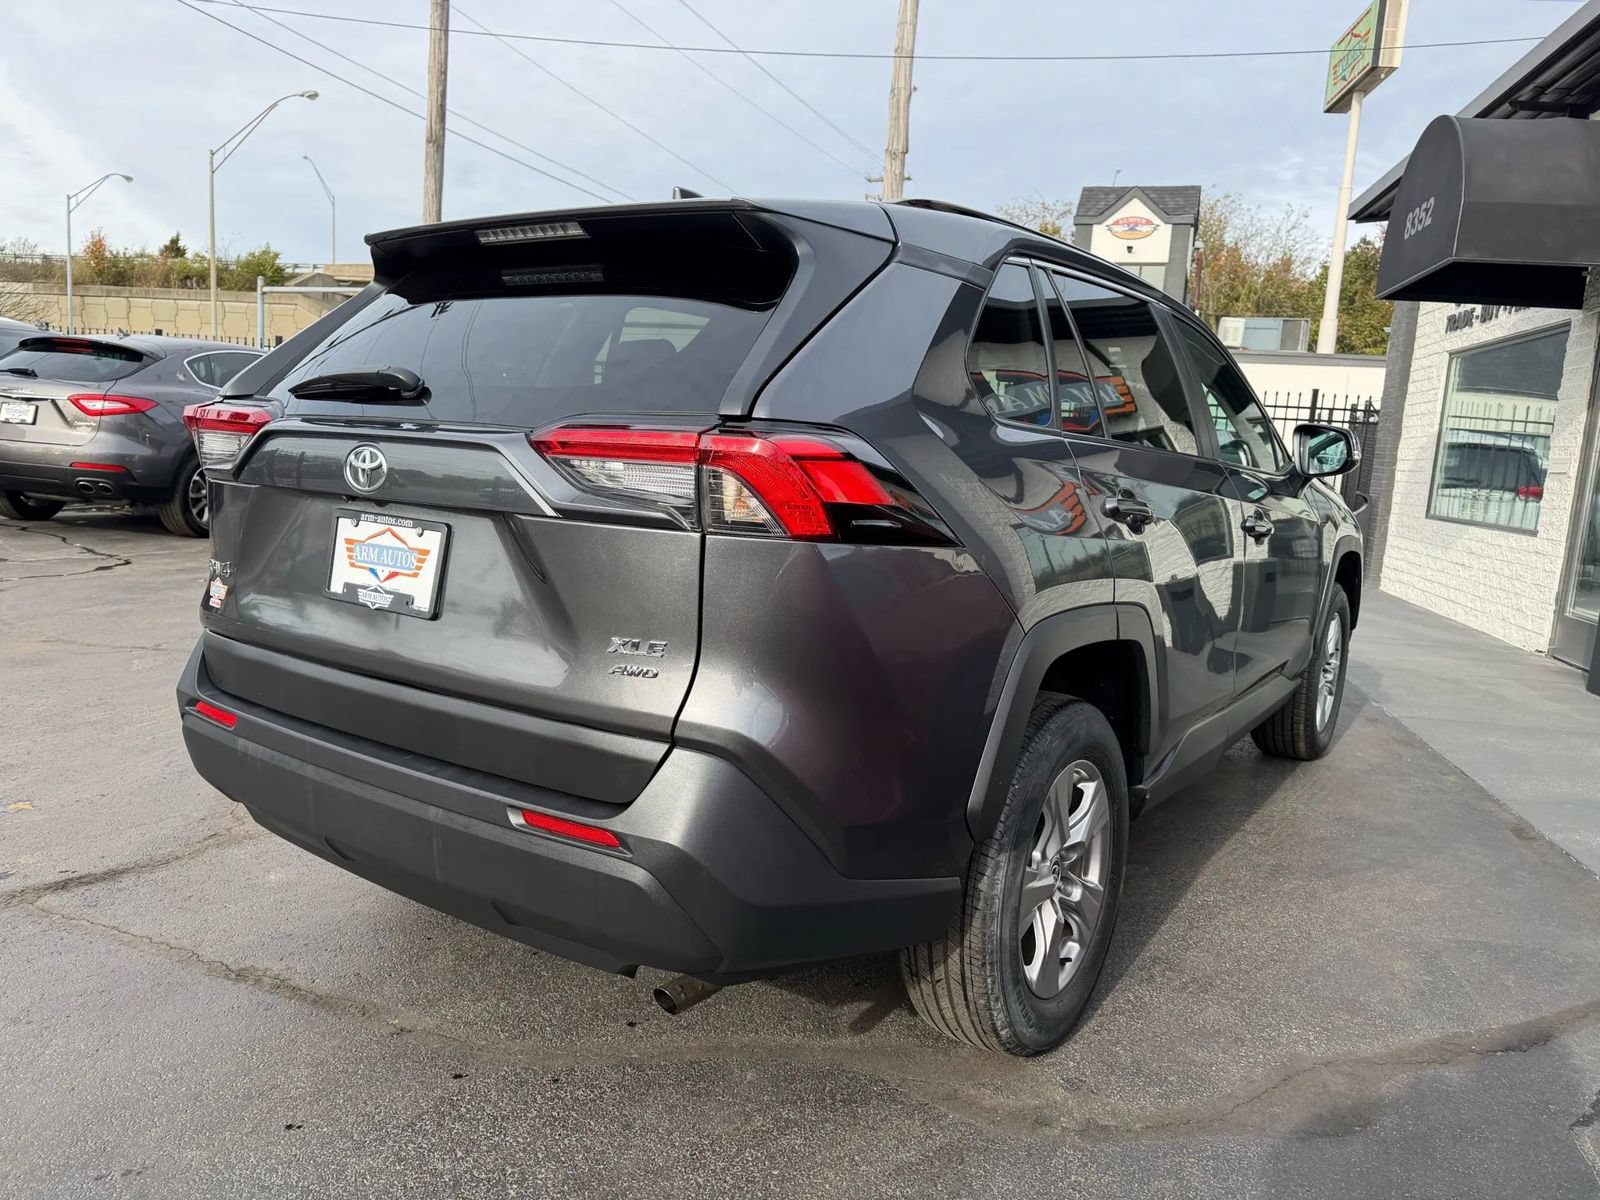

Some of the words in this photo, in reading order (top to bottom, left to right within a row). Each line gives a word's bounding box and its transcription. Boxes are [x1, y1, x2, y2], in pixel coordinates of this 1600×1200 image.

[1404, 196, 1435, 240] 8352
[1445, 307, 1476, 334] TRADE
[360, 513, 413, 528] arm-autos.com
[354, 544, 378, 563] ARM
[380, 548, 418, 569] AUTOS
[606, 637, 668, 659] XLE
[608, 664, 659, 679] AWD
